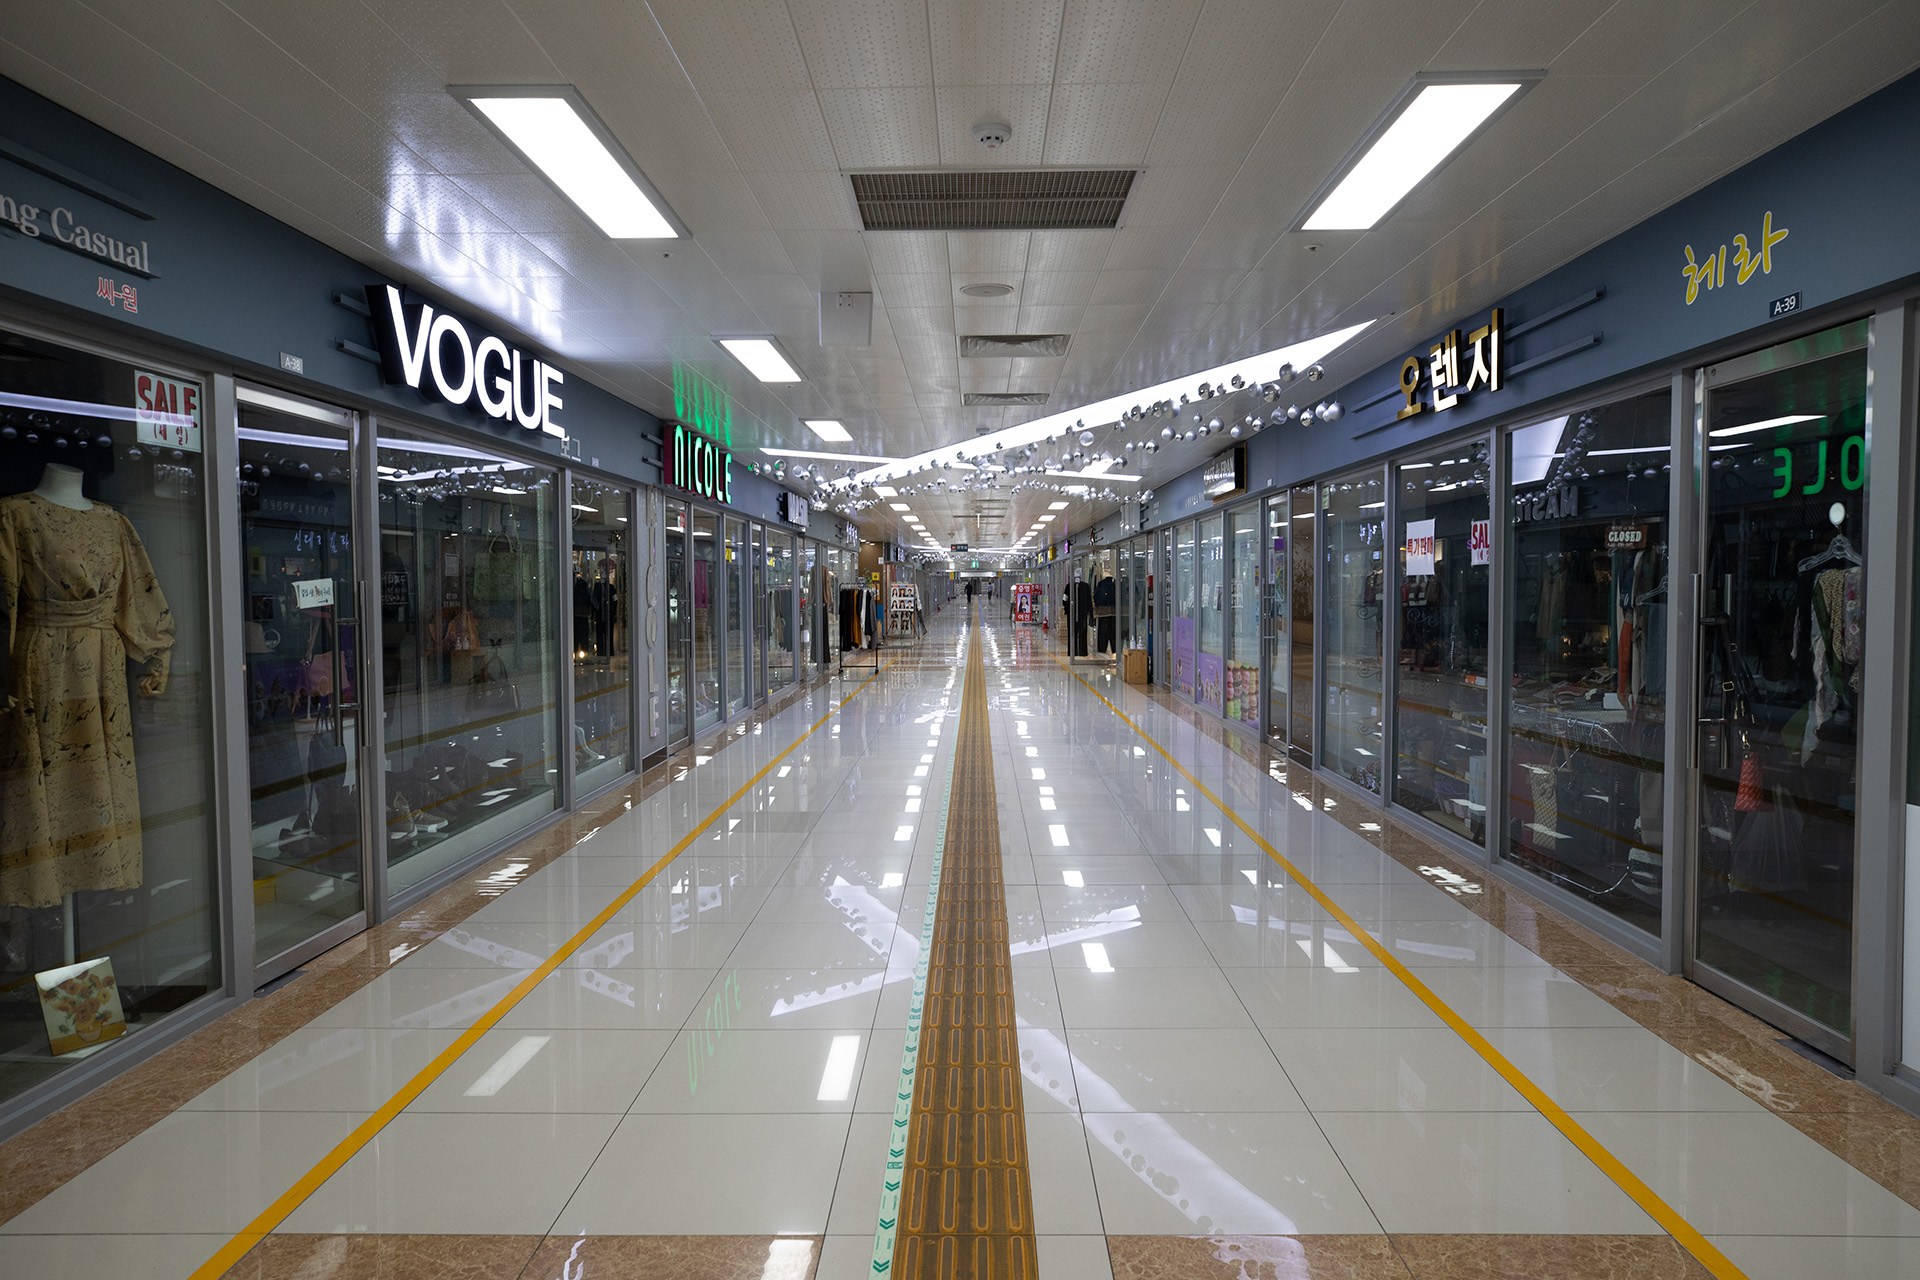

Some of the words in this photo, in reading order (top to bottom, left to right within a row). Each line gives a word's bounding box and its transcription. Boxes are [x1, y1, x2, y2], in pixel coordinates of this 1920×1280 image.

[50, 207, 150, 273] Casual
[1682, 211, 1789, 305] 헤라
[1773, 295, 1797, 316] A-39
[284, 355, 302, 372] A-38
[386, 284, 565, 439] VOGUE
[1397, 308, 1504, 421] 오렌지
[137, 375, 198, 428] SALE
[674, 424, 732, 505] NICOLE
[1608, 530, 1642, 543] CLOSED
